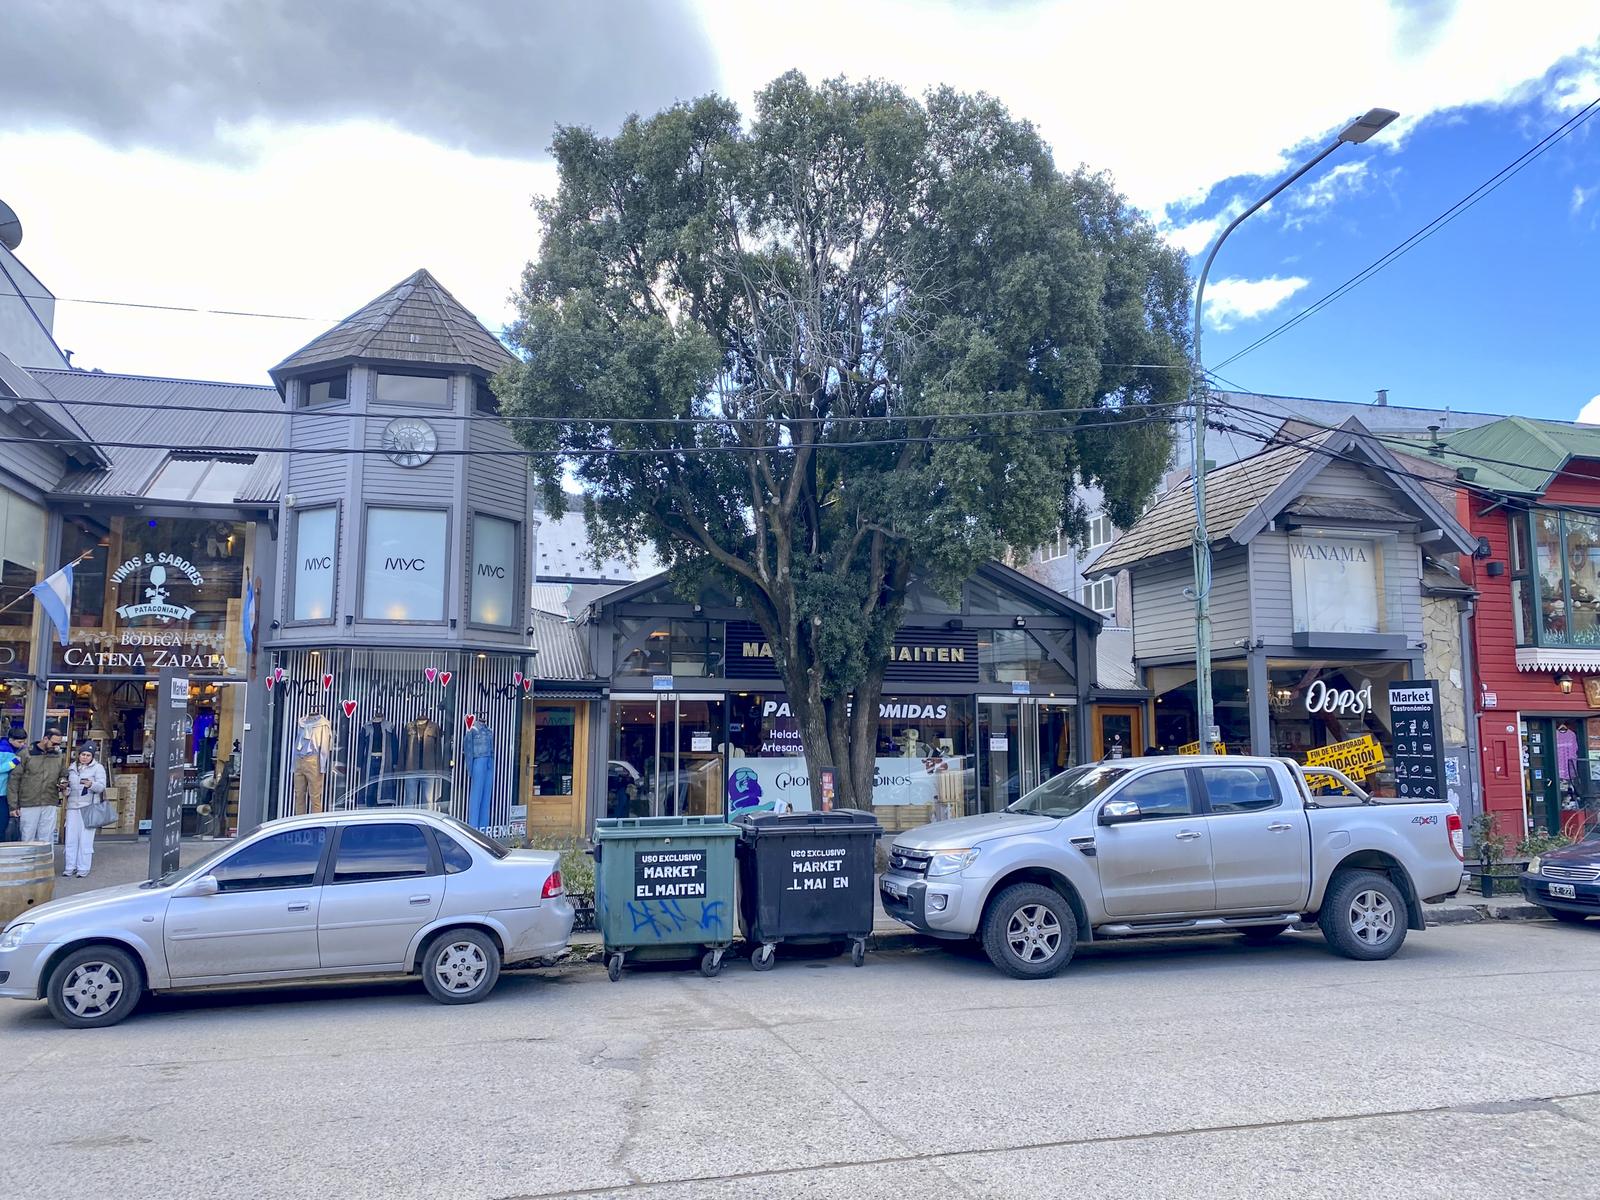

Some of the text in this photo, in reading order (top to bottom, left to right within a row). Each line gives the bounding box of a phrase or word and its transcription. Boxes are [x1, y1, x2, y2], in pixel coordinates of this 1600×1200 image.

[1290, 543, 1368, 562] WANAMA
[109, 551, 204, 587] VINOS & SABORES
[304, 556, 331, 571] MYC
[384, 557, 425, 571] MYC
[477, 563, 505, 579] MYC
[134, 605, 179, 615] PATAGONIAN
[121, 634, 182, 647] BODEGA
[742, 642, 774, 657] MA
[63, 648, 228, 668] CATENA ZAPATA
[1391, 691, 1430, 703] Market
[763, 701, 795, 717] PA
[1392, 704, 1432, 712] Gastronómico
[1310, 738, 1366, 759] FIN DE TEMPORADA
[641, 853, 702, 863] USO EXCLUSIVO
[807, 848, 846, 857] EXCLUSIVO
[643, 865, 698, 879] MARKET
[792, 860, 843, 873] MARKET
[636, 883, 705, 897] EL MAITEN
